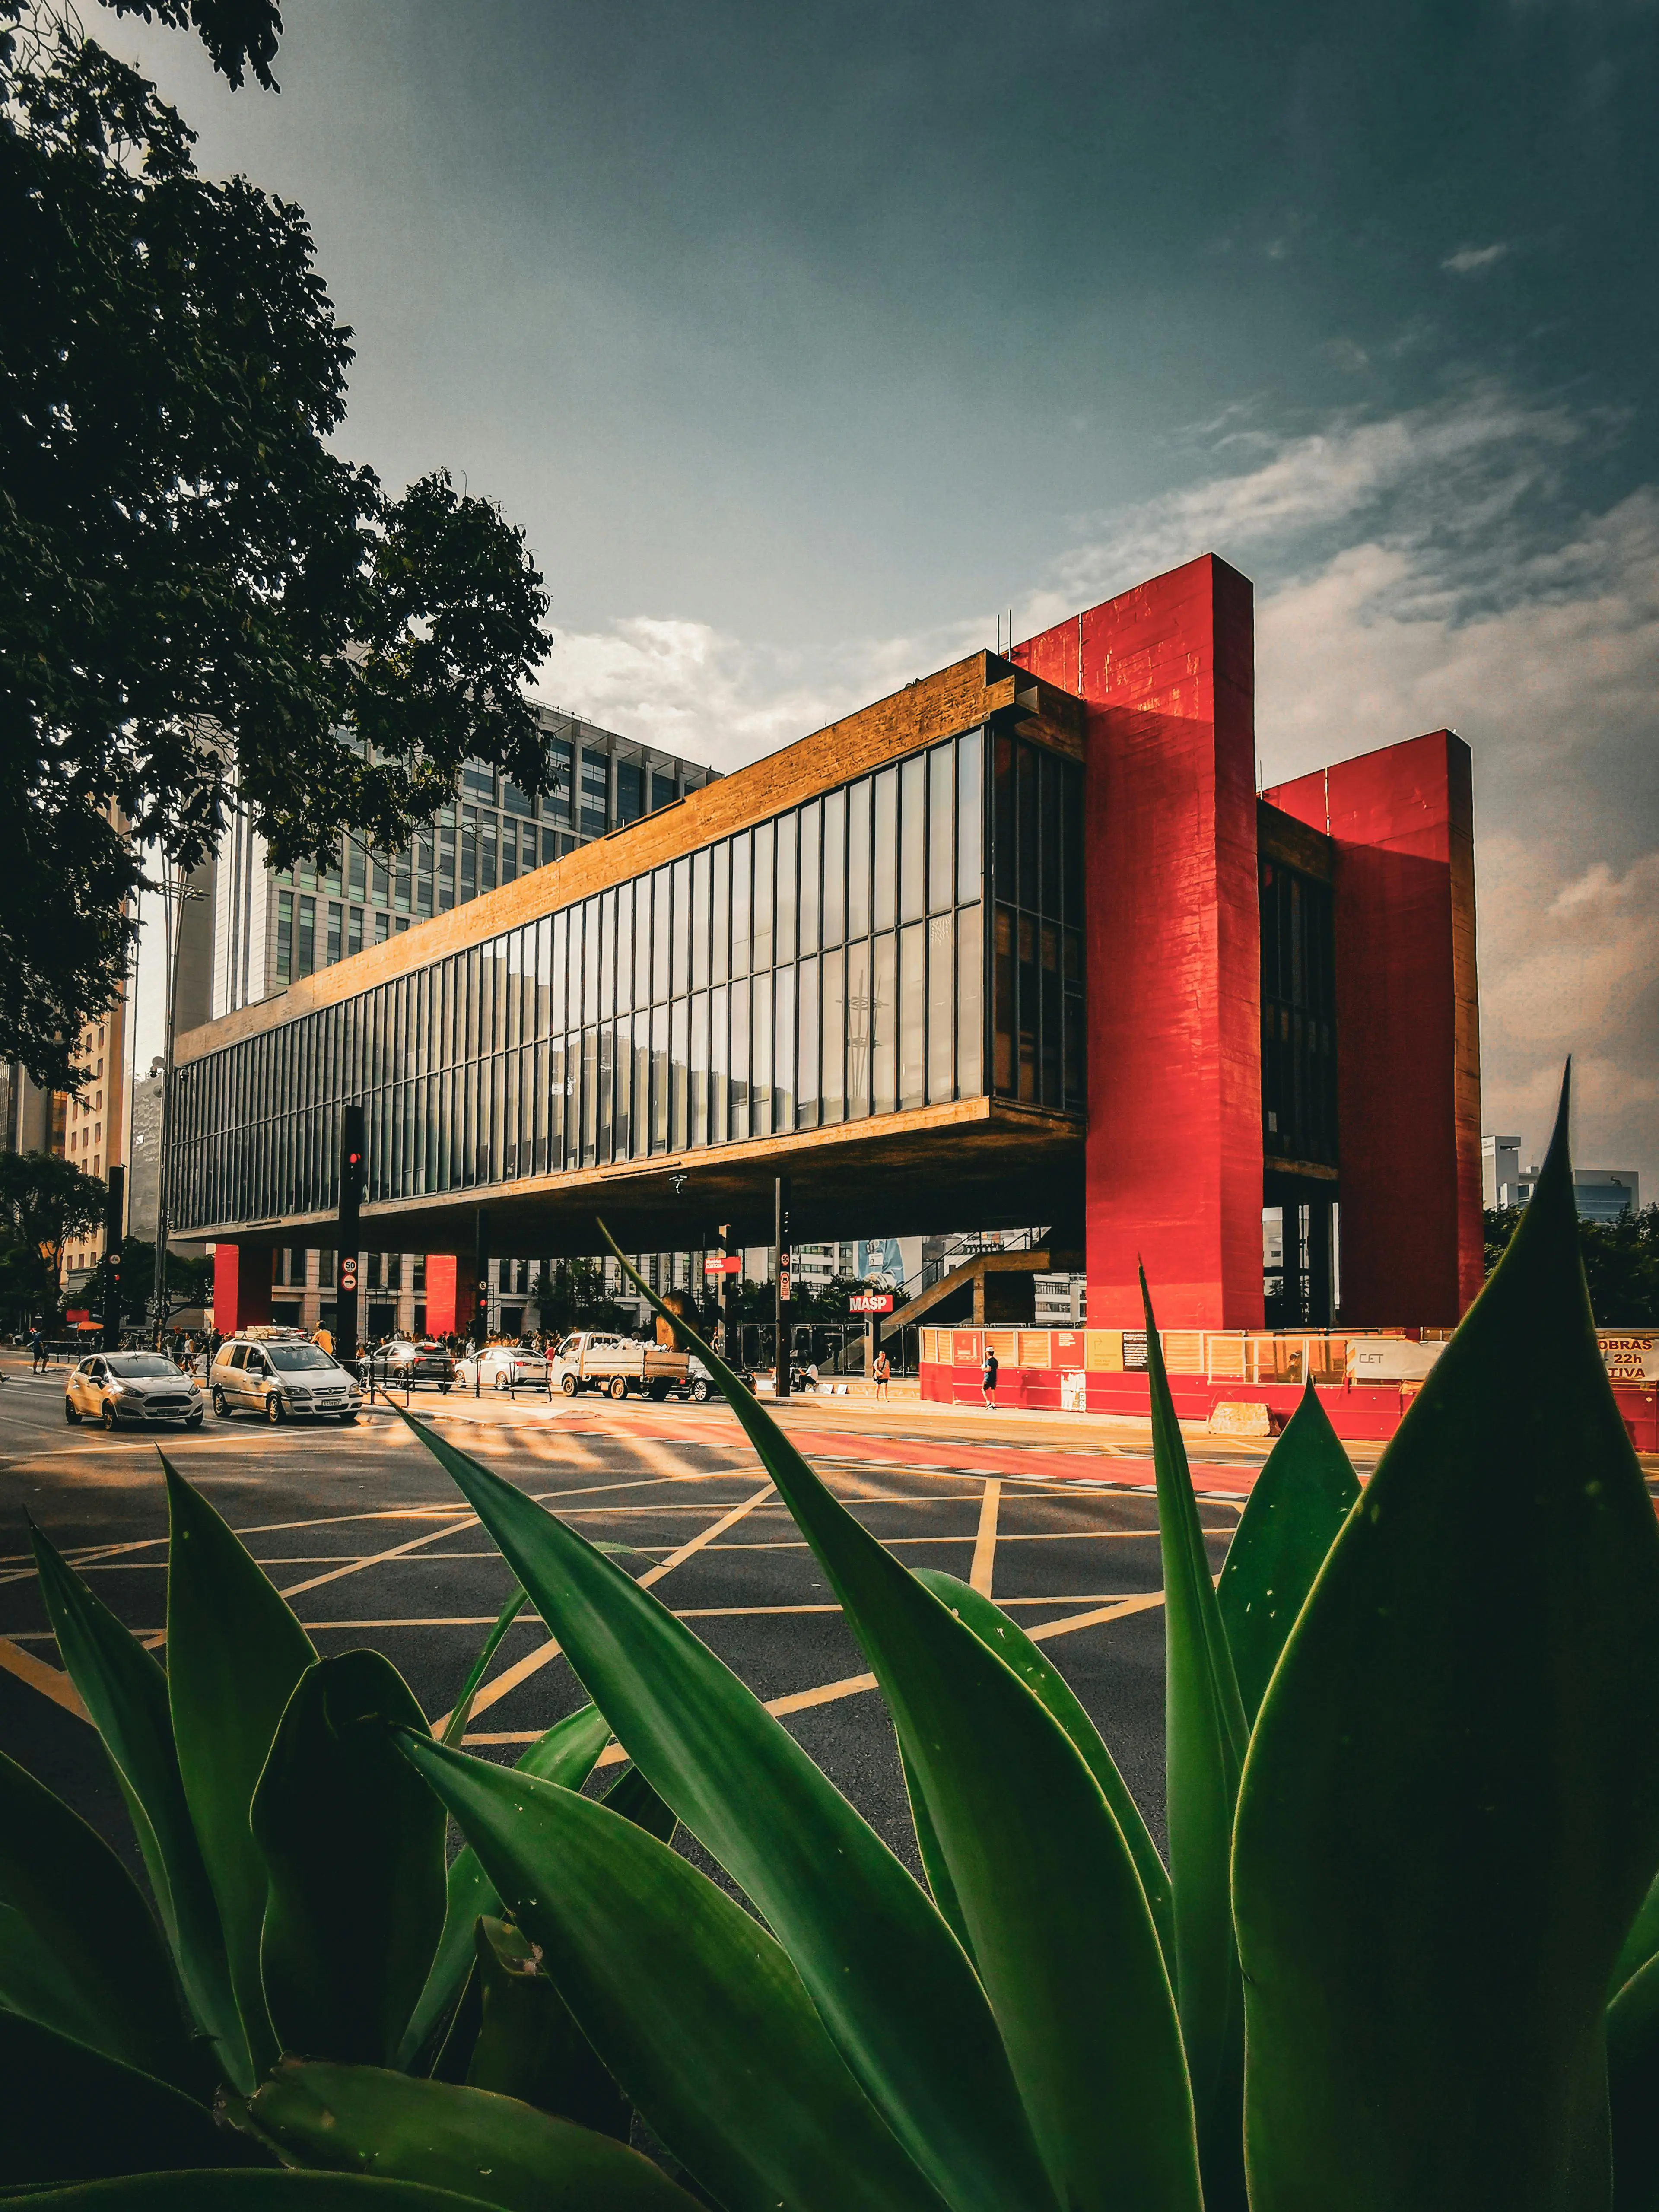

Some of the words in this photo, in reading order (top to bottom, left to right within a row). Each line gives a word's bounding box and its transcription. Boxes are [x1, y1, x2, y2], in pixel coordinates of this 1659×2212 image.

[850, 1297, 887, 1311] MASP
[1598, 1340, 1653, 1350] OBRAS
[1360, 1354, 1384, 1363] CET
[1614, 1354, 1642, 1363] 22h
